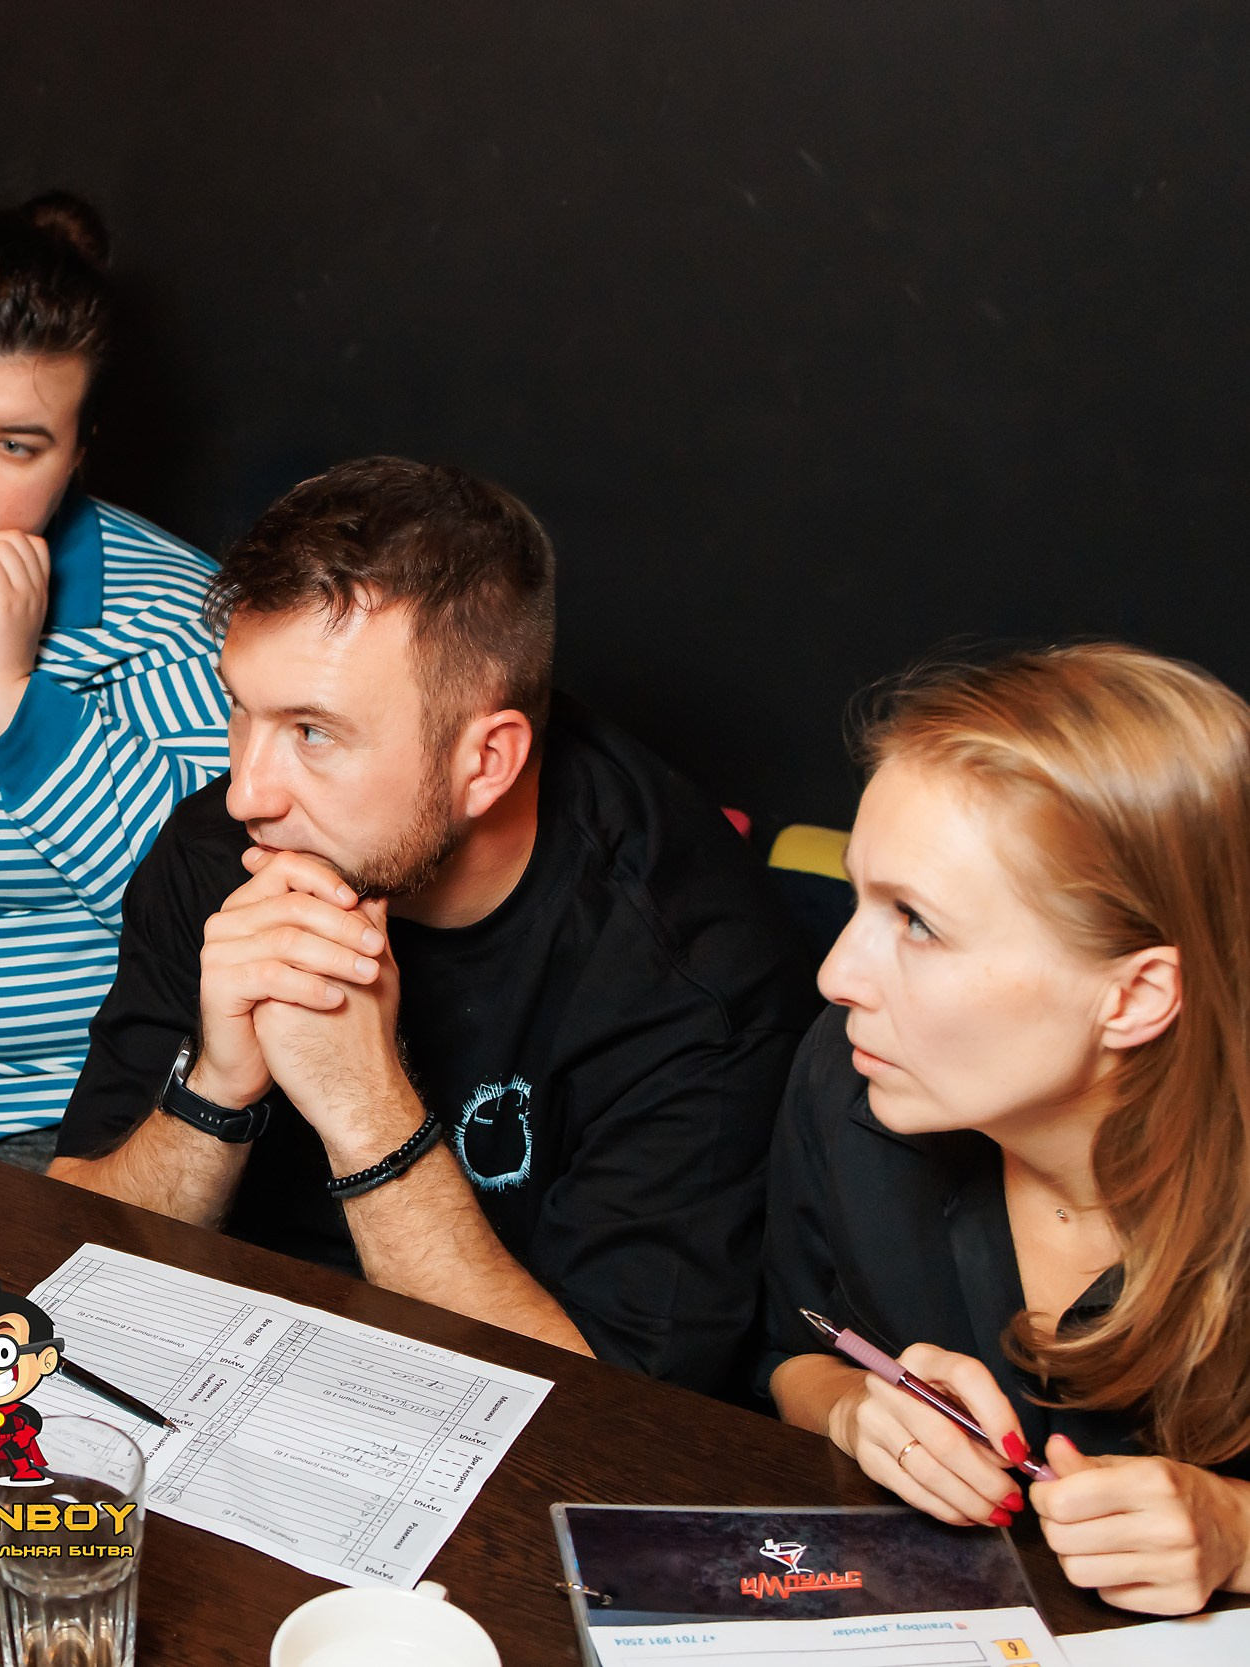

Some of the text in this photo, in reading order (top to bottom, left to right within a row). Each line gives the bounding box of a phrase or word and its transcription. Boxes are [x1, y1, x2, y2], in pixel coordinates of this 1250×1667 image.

[261, 1318, 273, 1328] Все
[159, 1336, 184, 1348] Ответ
[244, 1333, 260, 1346] ZERO
[219, 1357, 245, 1369] РАУНД
[188, 1373, 216, 1402] пьедесталу
[206, 1378, 227, 1400] Ступени
[368, 1404, 396, 1416] Ответ
[484, 1395, 508, 1422] Мешанина
[459, 1434, 487, 1446] РАУНД
[472, 1455, 483, 1467] Зри
[320, 1465, 349, 1478] Ответ
[453, 1468, 470, 1492] корень
[413, 1499, 442, 1512] РАУНД
[269, 1528, 299, 1544] Ответ
[393, 1522, 419, 1550] Разминка
[364, 1566, 394, 1580] РАУНД
[740, 1571, 863, 1600] ИМПУЛЬС
[833, 1622, 953, 1636] brainboy_pavlodar
[614, 1634, 717, 1646] +7 701 991 2504
[1007, 1641, 1018, 1655] 6
